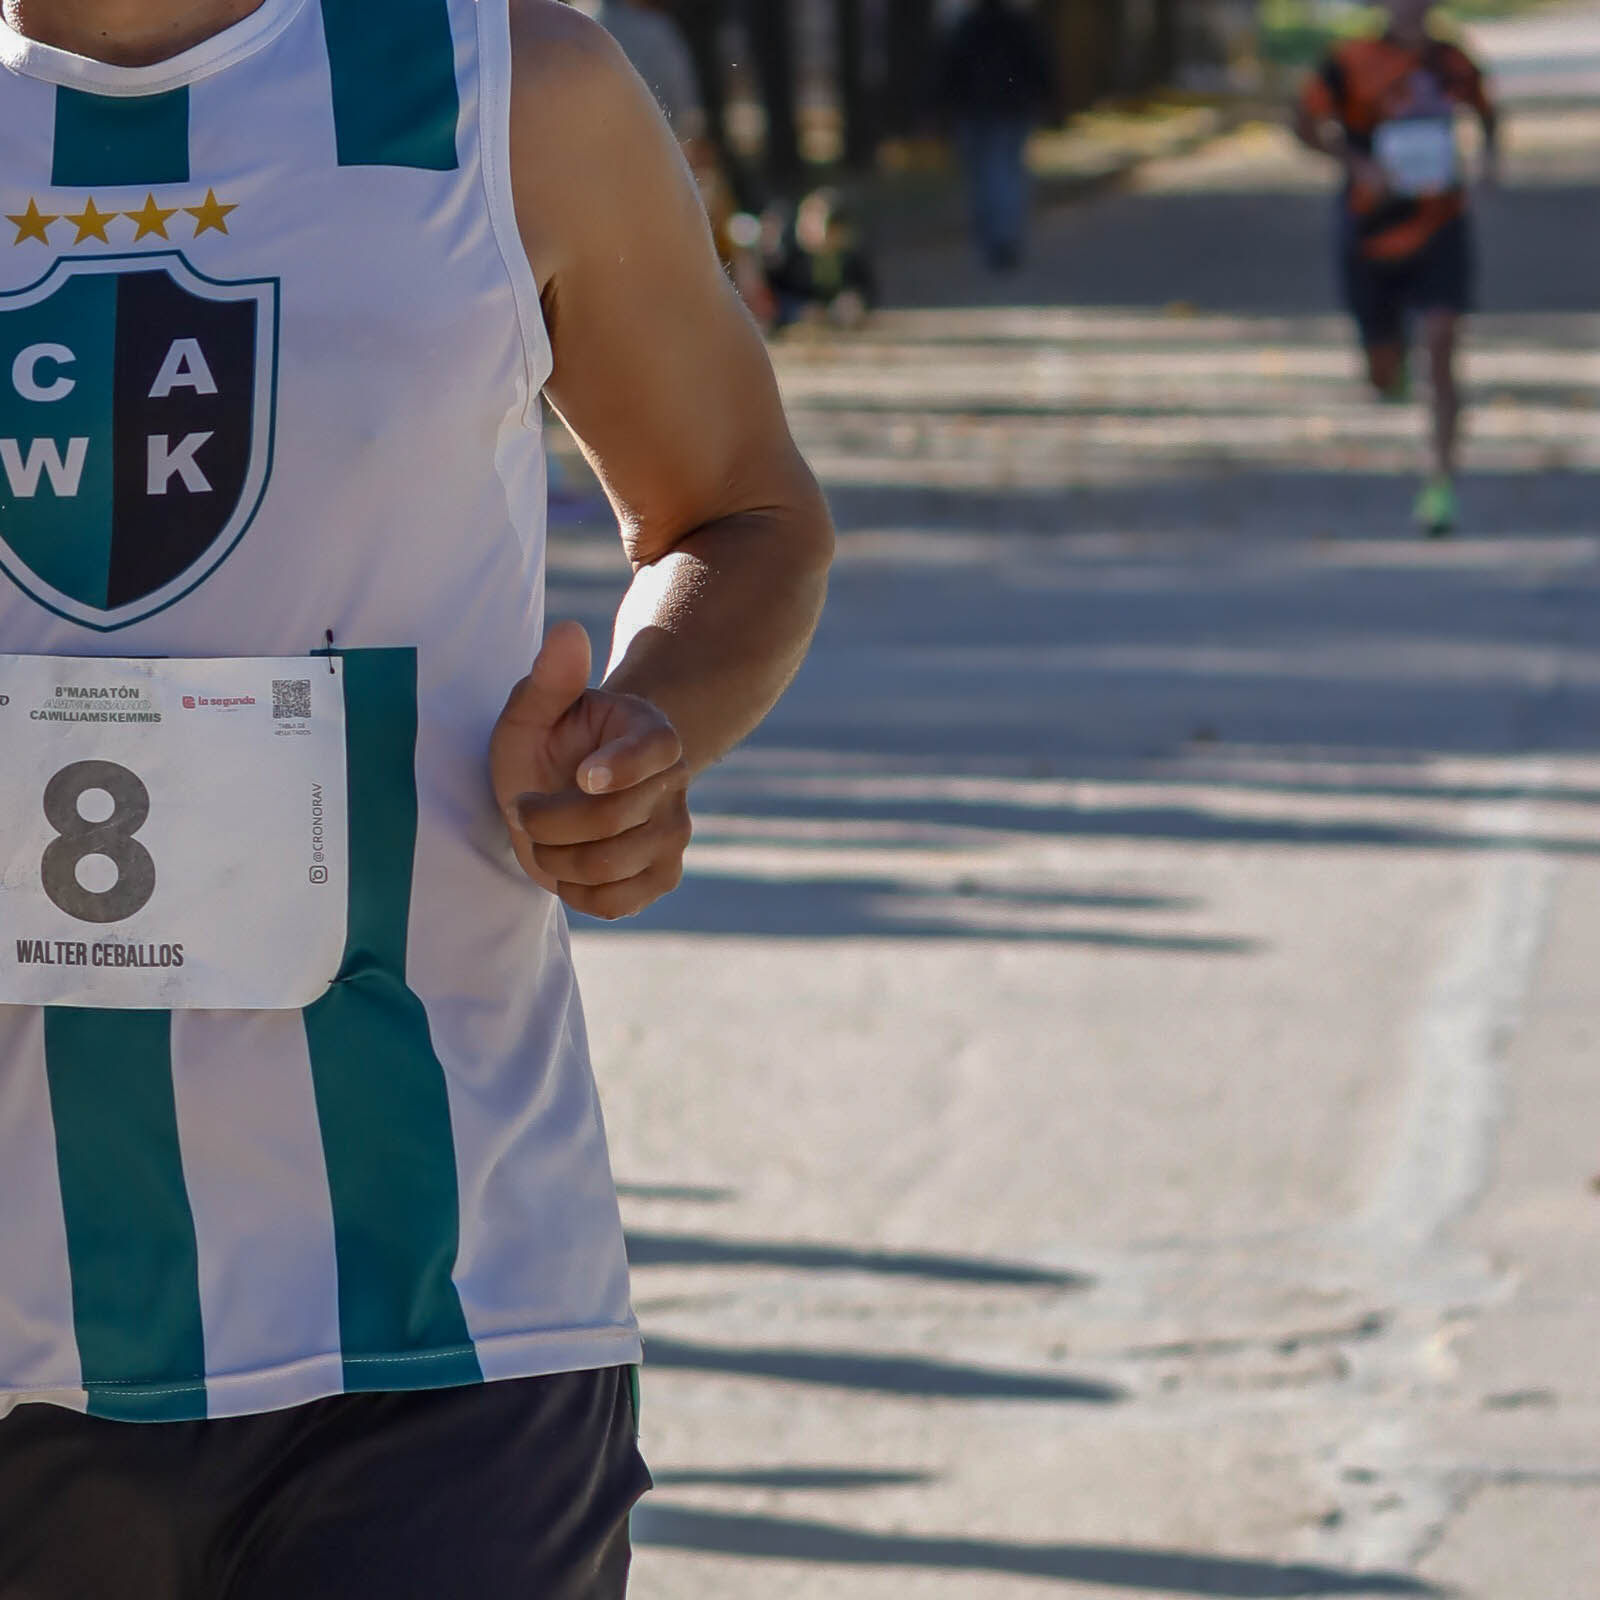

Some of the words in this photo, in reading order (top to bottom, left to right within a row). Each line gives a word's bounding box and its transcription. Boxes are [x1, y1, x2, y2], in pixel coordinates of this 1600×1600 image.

[12, 343, 77, 402] C
[148, 338, 219, 398] A
[146, 431, 215, 495] K
[41, 760, 156, 923] 8
[312, 783, 324, 862] @CRONORAV
[16, 939, 87, 966] WALTER
[91, 943, 184, 968] CEBALLOS
